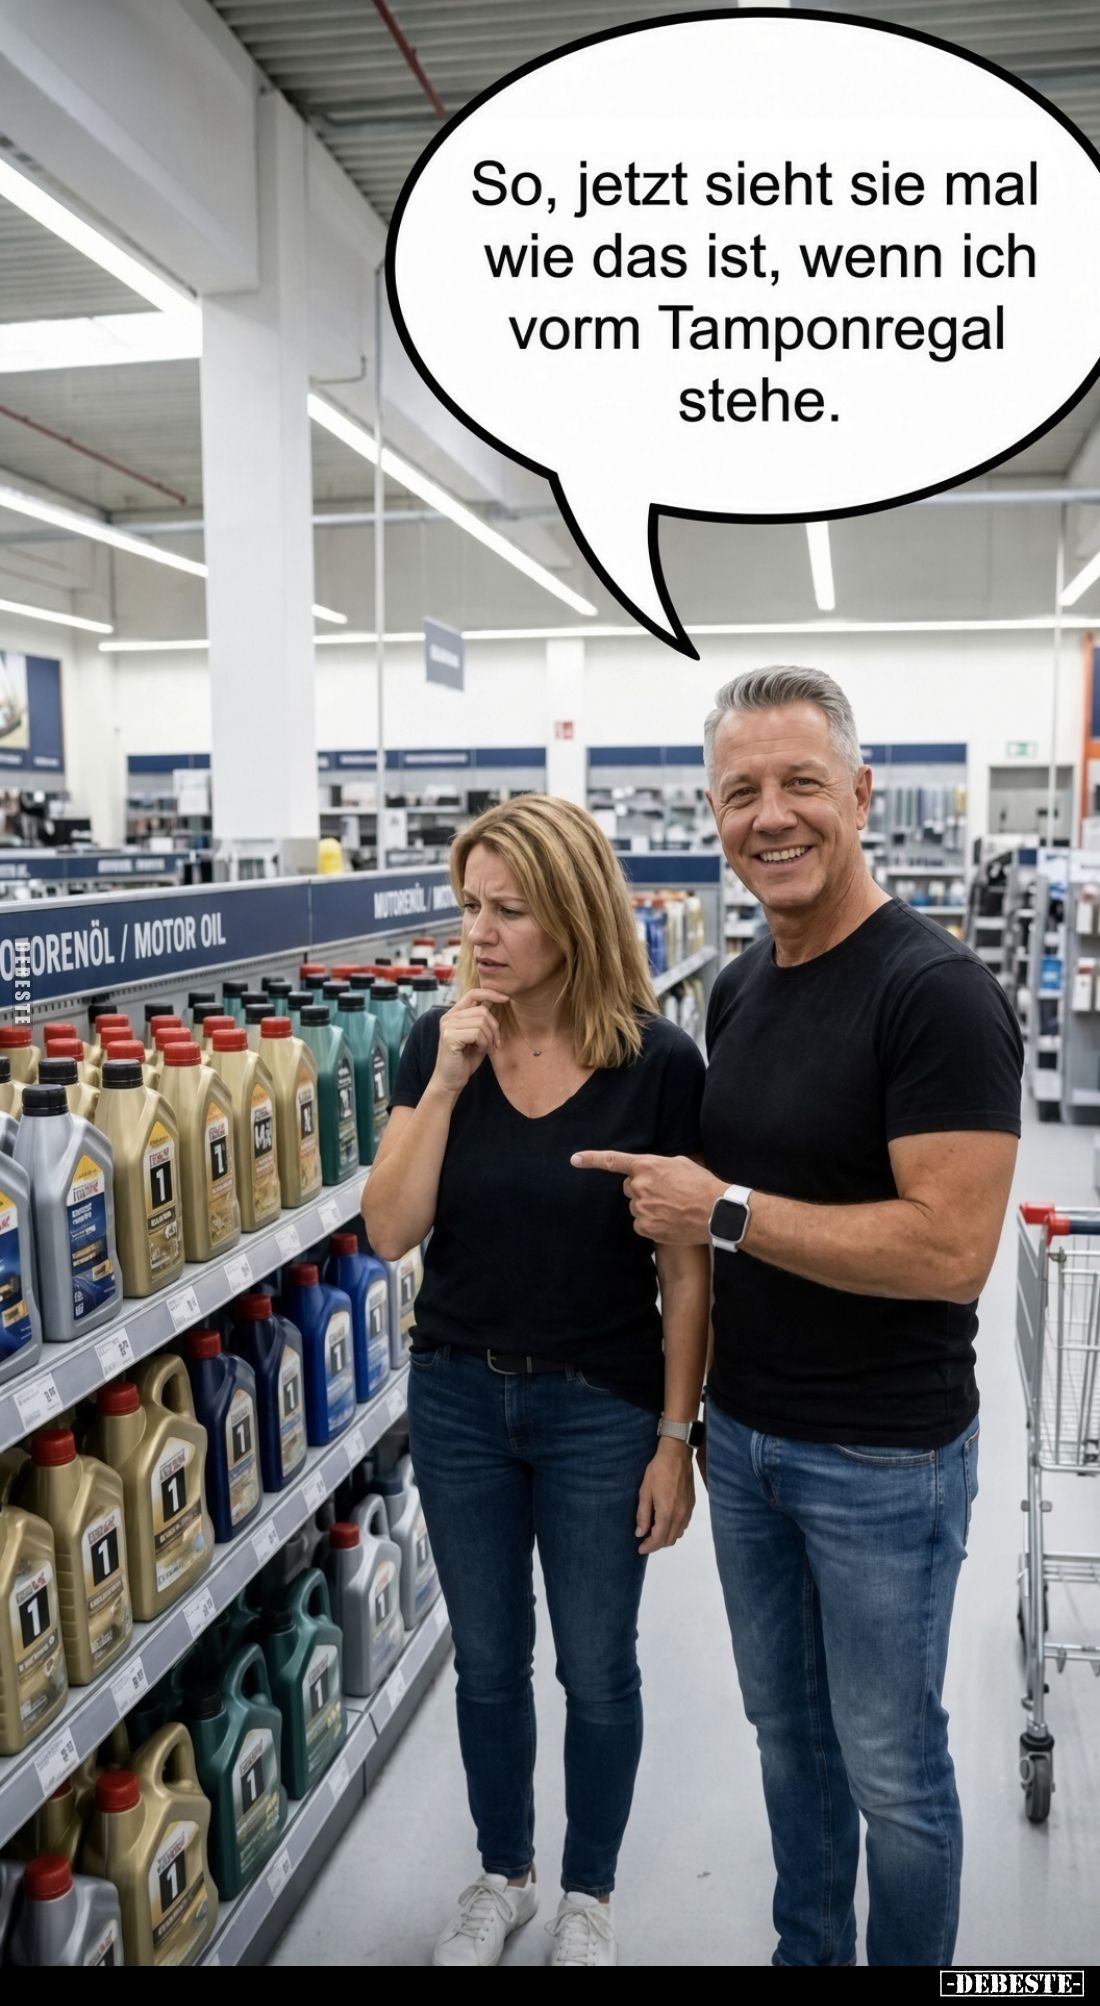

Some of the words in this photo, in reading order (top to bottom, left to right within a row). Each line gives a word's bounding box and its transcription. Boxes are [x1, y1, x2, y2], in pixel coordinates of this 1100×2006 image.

[134, 916, 196, 959] MOTOR
[201, 912, 226, 948] OIL
[214, 1143, 224, 1174] 1
[156, 1167, 166, 1202] 1
[403, 1276, 411, 1300] 1
[372, 1311, 381, 1332] 1
[335, 1350, 343, 1372] 1
[286, 1384, 295, 1409] 1
[237, 1424, 246, 1452] 1
[168, 1477, 179, 1512] 1
[98, 1538, 110, 1576] 1
[418, 1540, 426, 1561] 1
[27, 1597, 40, 1637] 1
[377, 1597, 385, 1618] 1
[314, 1677, 324, 1709] 1
[247, 1767, 256, 1801] 1
[166, 1862, 178, 1900] 1
